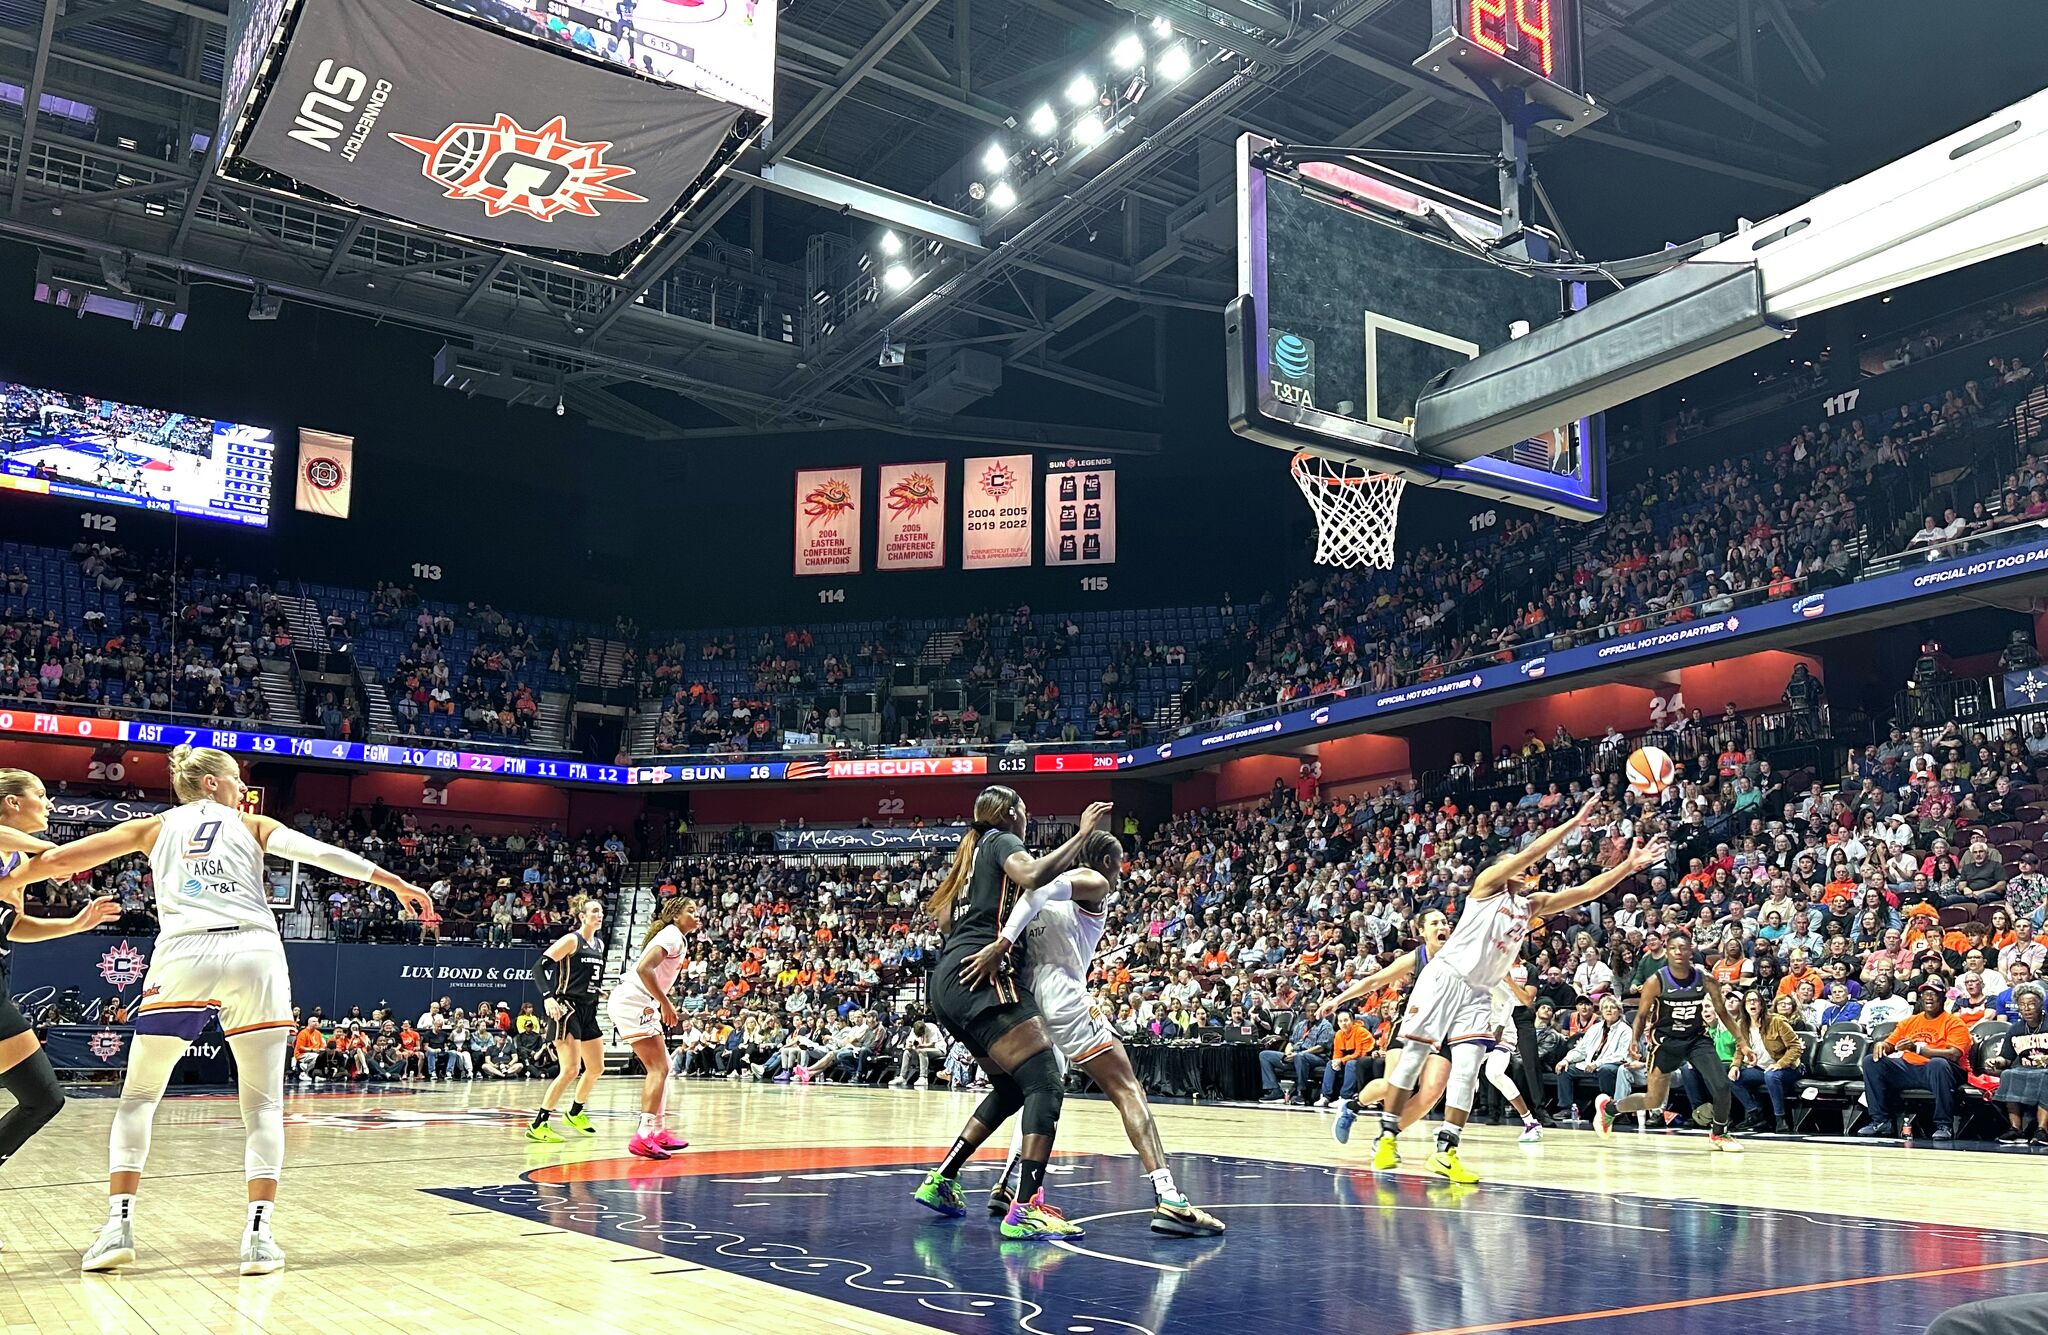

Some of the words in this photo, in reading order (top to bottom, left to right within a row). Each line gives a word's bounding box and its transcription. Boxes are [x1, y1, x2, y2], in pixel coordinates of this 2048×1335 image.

[548, 2, 569, 17] SUN
[1470, 0, 1552, 76] 24
[287, 58, 367, 152] SUN
[340, 78, 393, 162] CONNECTICUT
[1823, 389, 1860, 417] 117
[1049, 461, 1066, 469] SUN
[1077, 458, 1112, 467] LEGENDS
[1063, 480, 1074, 490] 12
[1086, 479, 1098, 488] 42
[968, 509, 995, 519] 2004
[1000, 507, 1027, 517] 2005
[1062, 509, 1075, 519] 23
[1087, 508, 1097, 518] 13
[1469, 509, 1497, 531] 116
[80, 512, 117, 532] 112
[902, 524, 921, 533] 2005
[968, 522, 996, 531] 2019
[1000, 520, 1027, 530] 2022
[819, 530, 837, 539] 2004
[895, 533, 928, 542] EASTERN
[811, 538, 845, 547] EASTERN
[886, 541, 936, 551] CONFERENCE
[1063, 540, 1073, 549] 15
[1088, 539, 1095, 548] 11
[803, 547, 852, 557] CONFERENCE
[888, 550, 933, 561] CHAMPIONS
[805, 556, 850, 566] CHAMPIONS
[411, 562, 442, 580] 113
[1914, 568, 1967, 587] OFFICIAL
[1967, 560, 1997, 575] HOT
[1996, 554, 2026, 569] DOG
[1080, 577, 1108, 591] 115
[818, 589, 845, 604] 114
[1598, 642, 1637, 658] OFFICIAL
[1637, 636, 1659, 650] HOT
[1658, 631, 1680, 645] DOG
[1679, 621, 1725, 640] PARTNER
[1377, 693, 1405, 707] OFFICIAL
[1406, 689, 1422, 700] HOT
[1421, 685, 1437, 698] DOG
[1437, 679, 1471, 694] PARTNER
[1649, 693, 1684, 720] 24
[34, 714, 59, 733] FTA
[78, 721, 92, 735] 0
[138, 725, 164, 743] AST
[185, 731, 198, 745] 7
[212, 731, 238, 749] REB
[252, 737, 276, 751] 19
[290, 738, 313, 755] T/O
[331, 744, 344, 758] 4
[363, 744, 389, 762] FGM
[402, 751, 424, 766] 10
[436, 752, 458, 769] FGA
[470, 757, 492, 771] 22
[504, 758, 526, 774] FTM
[537, 763, 557, 777] 11
[569, 762, 588, 779] FTA
[598, 769, 618, 782] 12
[834, 760, 939, 775] MERCURY
[951, 760, 973, 773] 33
[998, 756, 1026, 772] 6:15
[1055, 757, 1064, 770] 5
[1093, 757, 1113, 767] 2ND
[87, 761, 125, 782] 20
[681, 767, 726, 781] SUN
[750, 766, 770, 780] 16
[422, 788, 448, 806] 21
[112, 803, 162, 821] Sun
[877, 798, 905, 815] 22
[184, 821, 222, 858] 9
[798, 829, 868, 849] Mohegan
[871, 831, 904, 847] Sun
[907, 828, 962, 846] Arena
[205, 881, 238, 894] T&T
[401, 965, 434, 979] LUX
[437, 966, 482, 980] BOND
[487, 968, 500, 981] &
[591, 965, 601, 981] 3
[1671, 1005, 1697, 1020] 22
[183, 1041, 222, 1059] nity
